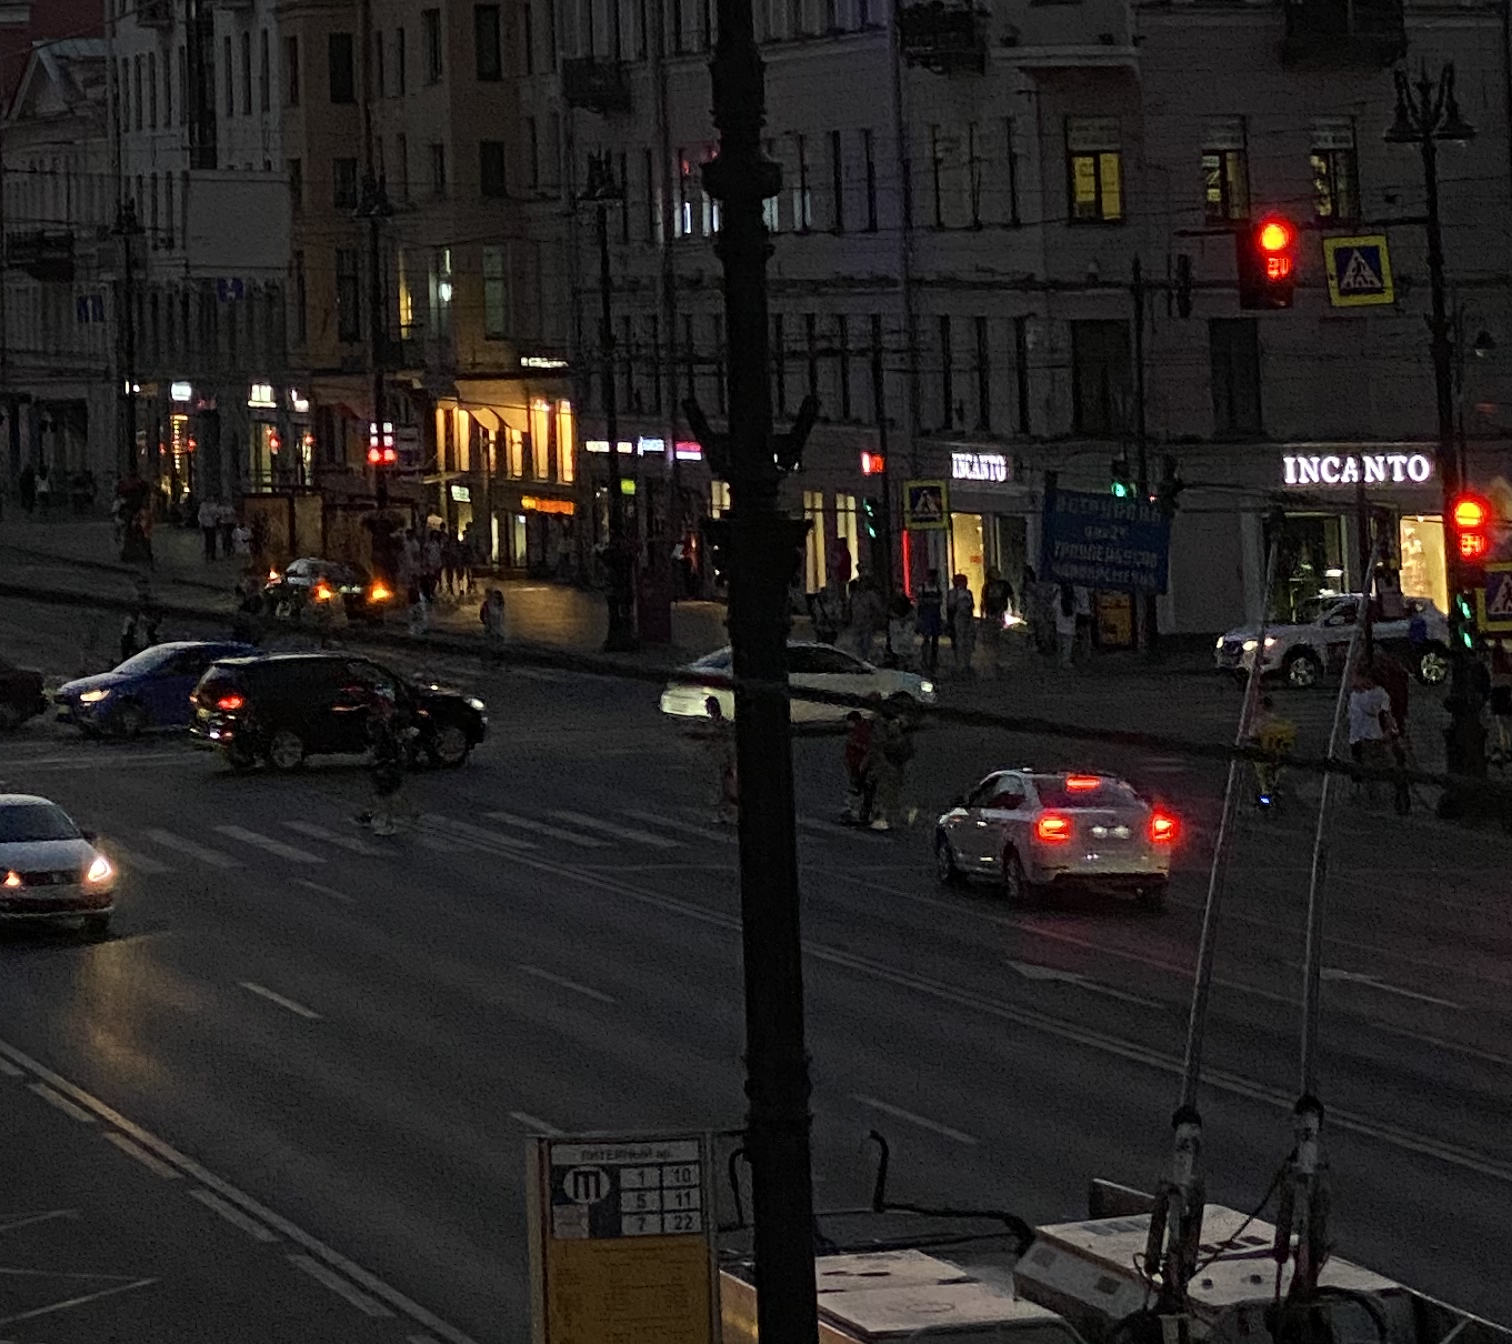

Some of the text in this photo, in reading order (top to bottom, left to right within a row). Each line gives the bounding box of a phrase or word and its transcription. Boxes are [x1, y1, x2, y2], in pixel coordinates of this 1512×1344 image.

[1283, 454, 1430, 483] INCANTO
[638, 1168, 691, 1185] 1 10
[675, 1191, 691, 1207] 11
[674, 1215, 693, 1231] 22
